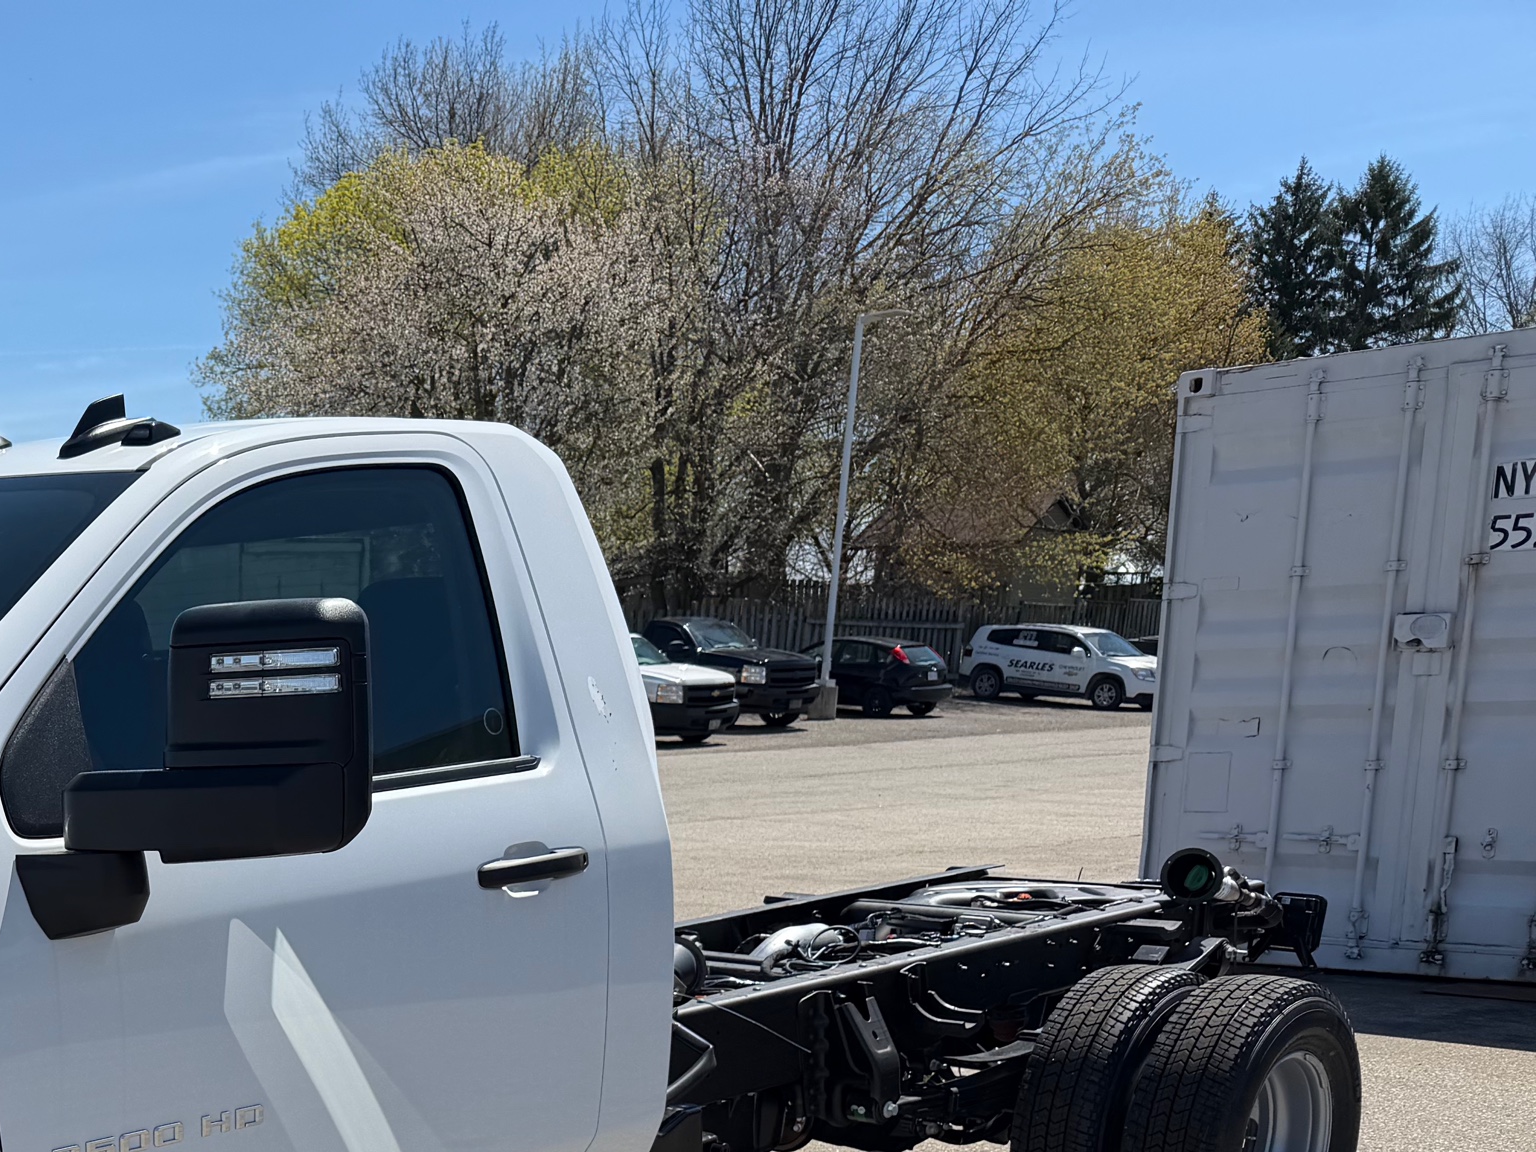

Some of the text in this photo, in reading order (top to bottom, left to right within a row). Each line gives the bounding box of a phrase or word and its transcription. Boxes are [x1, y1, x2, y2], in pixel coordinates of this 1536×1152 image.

[1489, 512, 1536, 550] 55
[1007, 659, 1055, 672] SEARLES
[200, 1103, 265, 1138] HD
